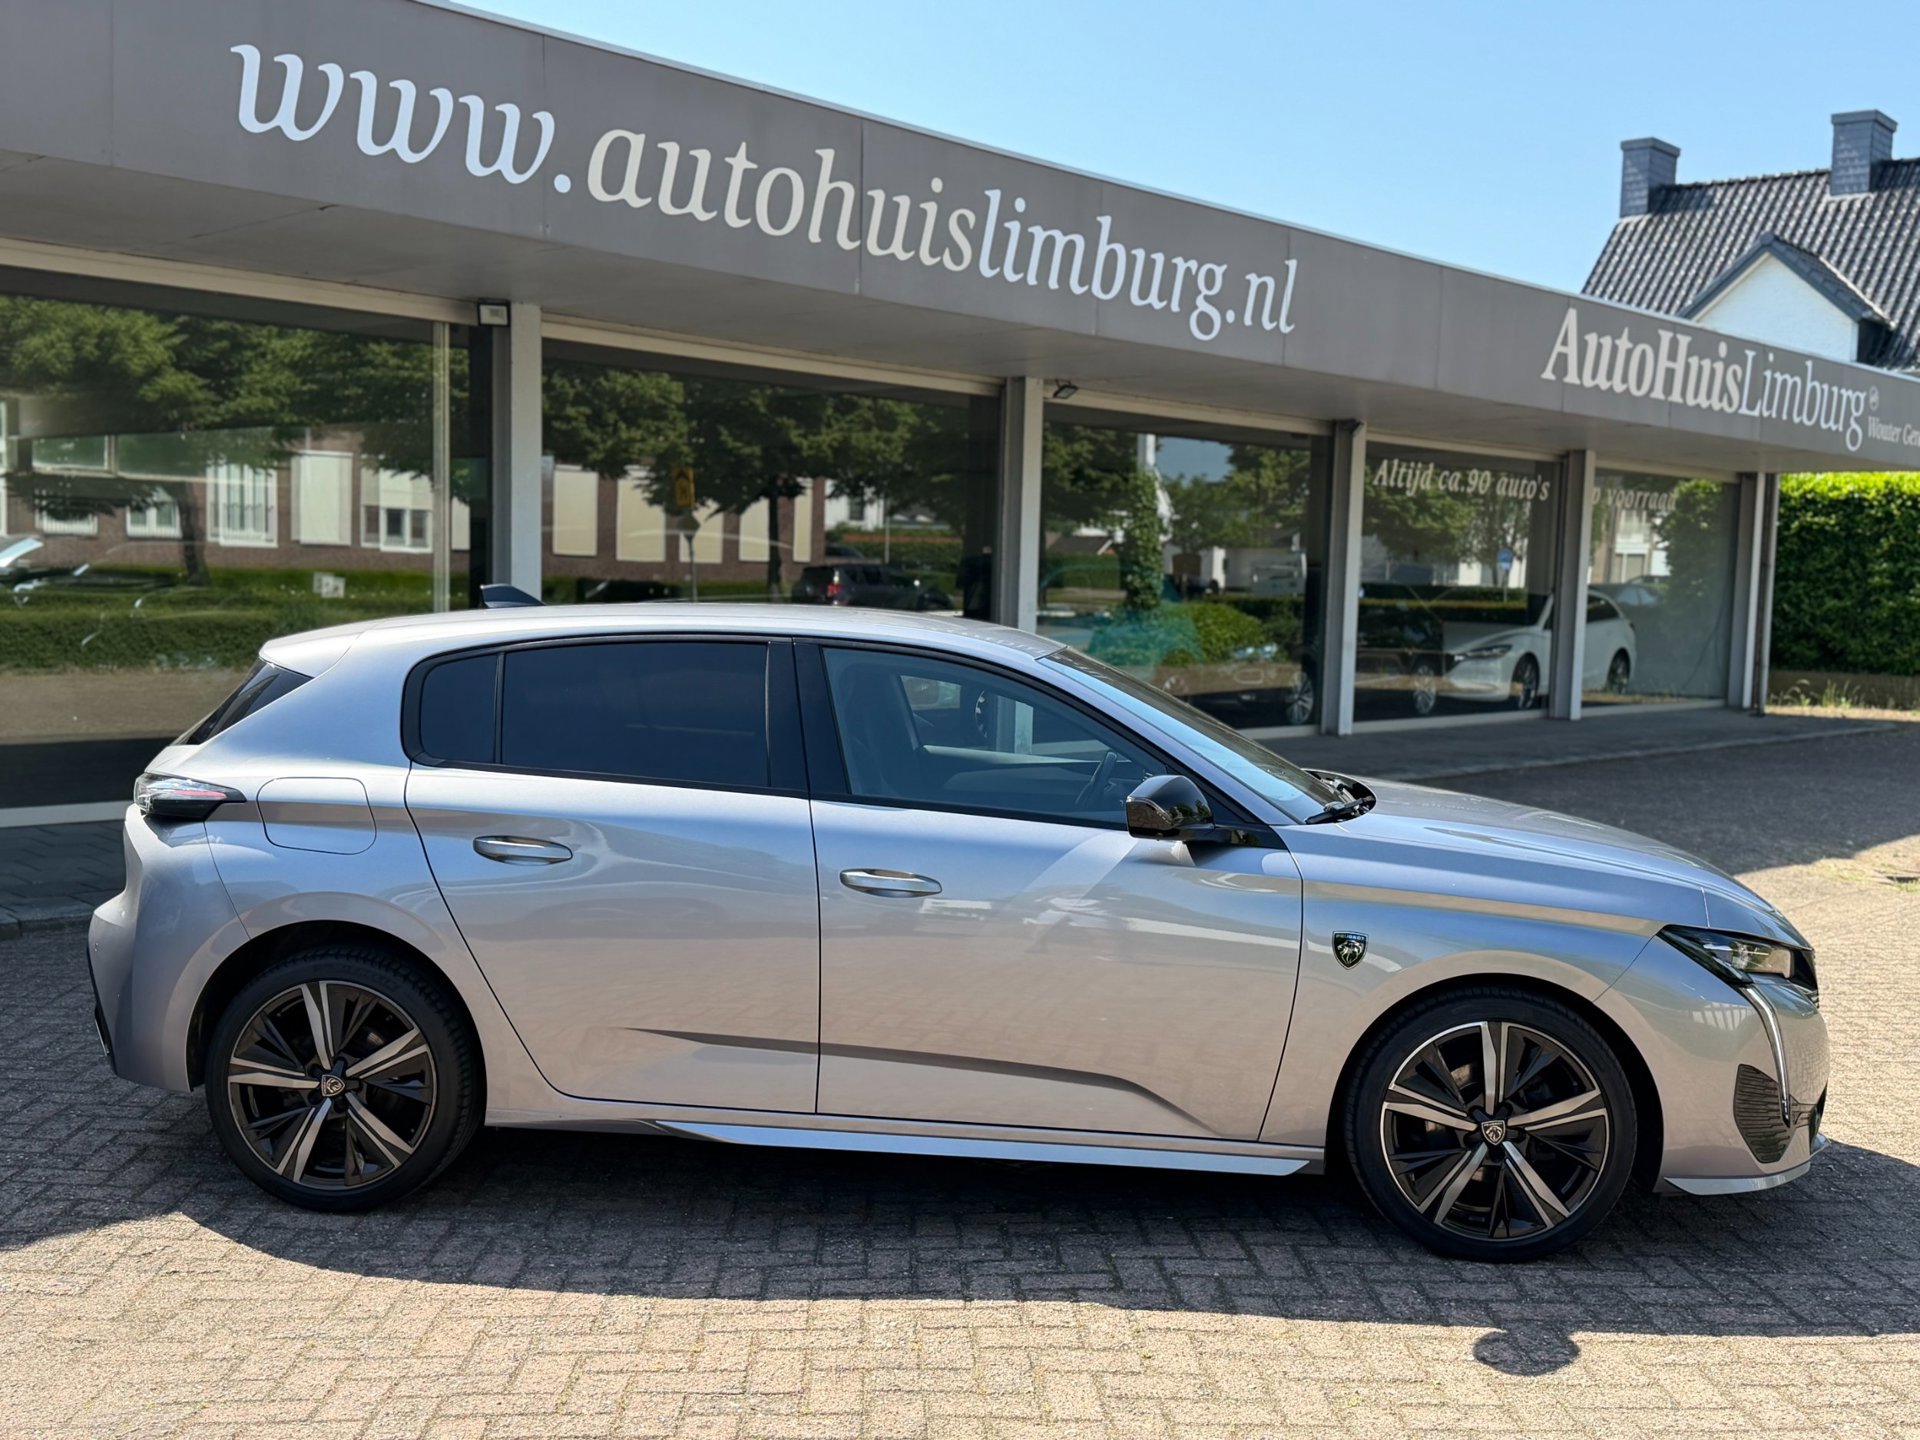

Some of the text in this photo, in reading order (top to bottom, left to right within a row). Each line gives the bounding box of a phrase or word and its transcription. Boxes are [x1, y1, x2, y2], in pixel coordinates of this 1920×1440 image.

[230, 44, 1297, 340] www.autohuislimburg.nl
[1540, 307, 1867, 452] AutoHuisLimburg
[1373, 458, 1434, 497] Altijd
[1438, 468, 1491, 495] ca.90
[1496, 474, 1550, 501] auto's
